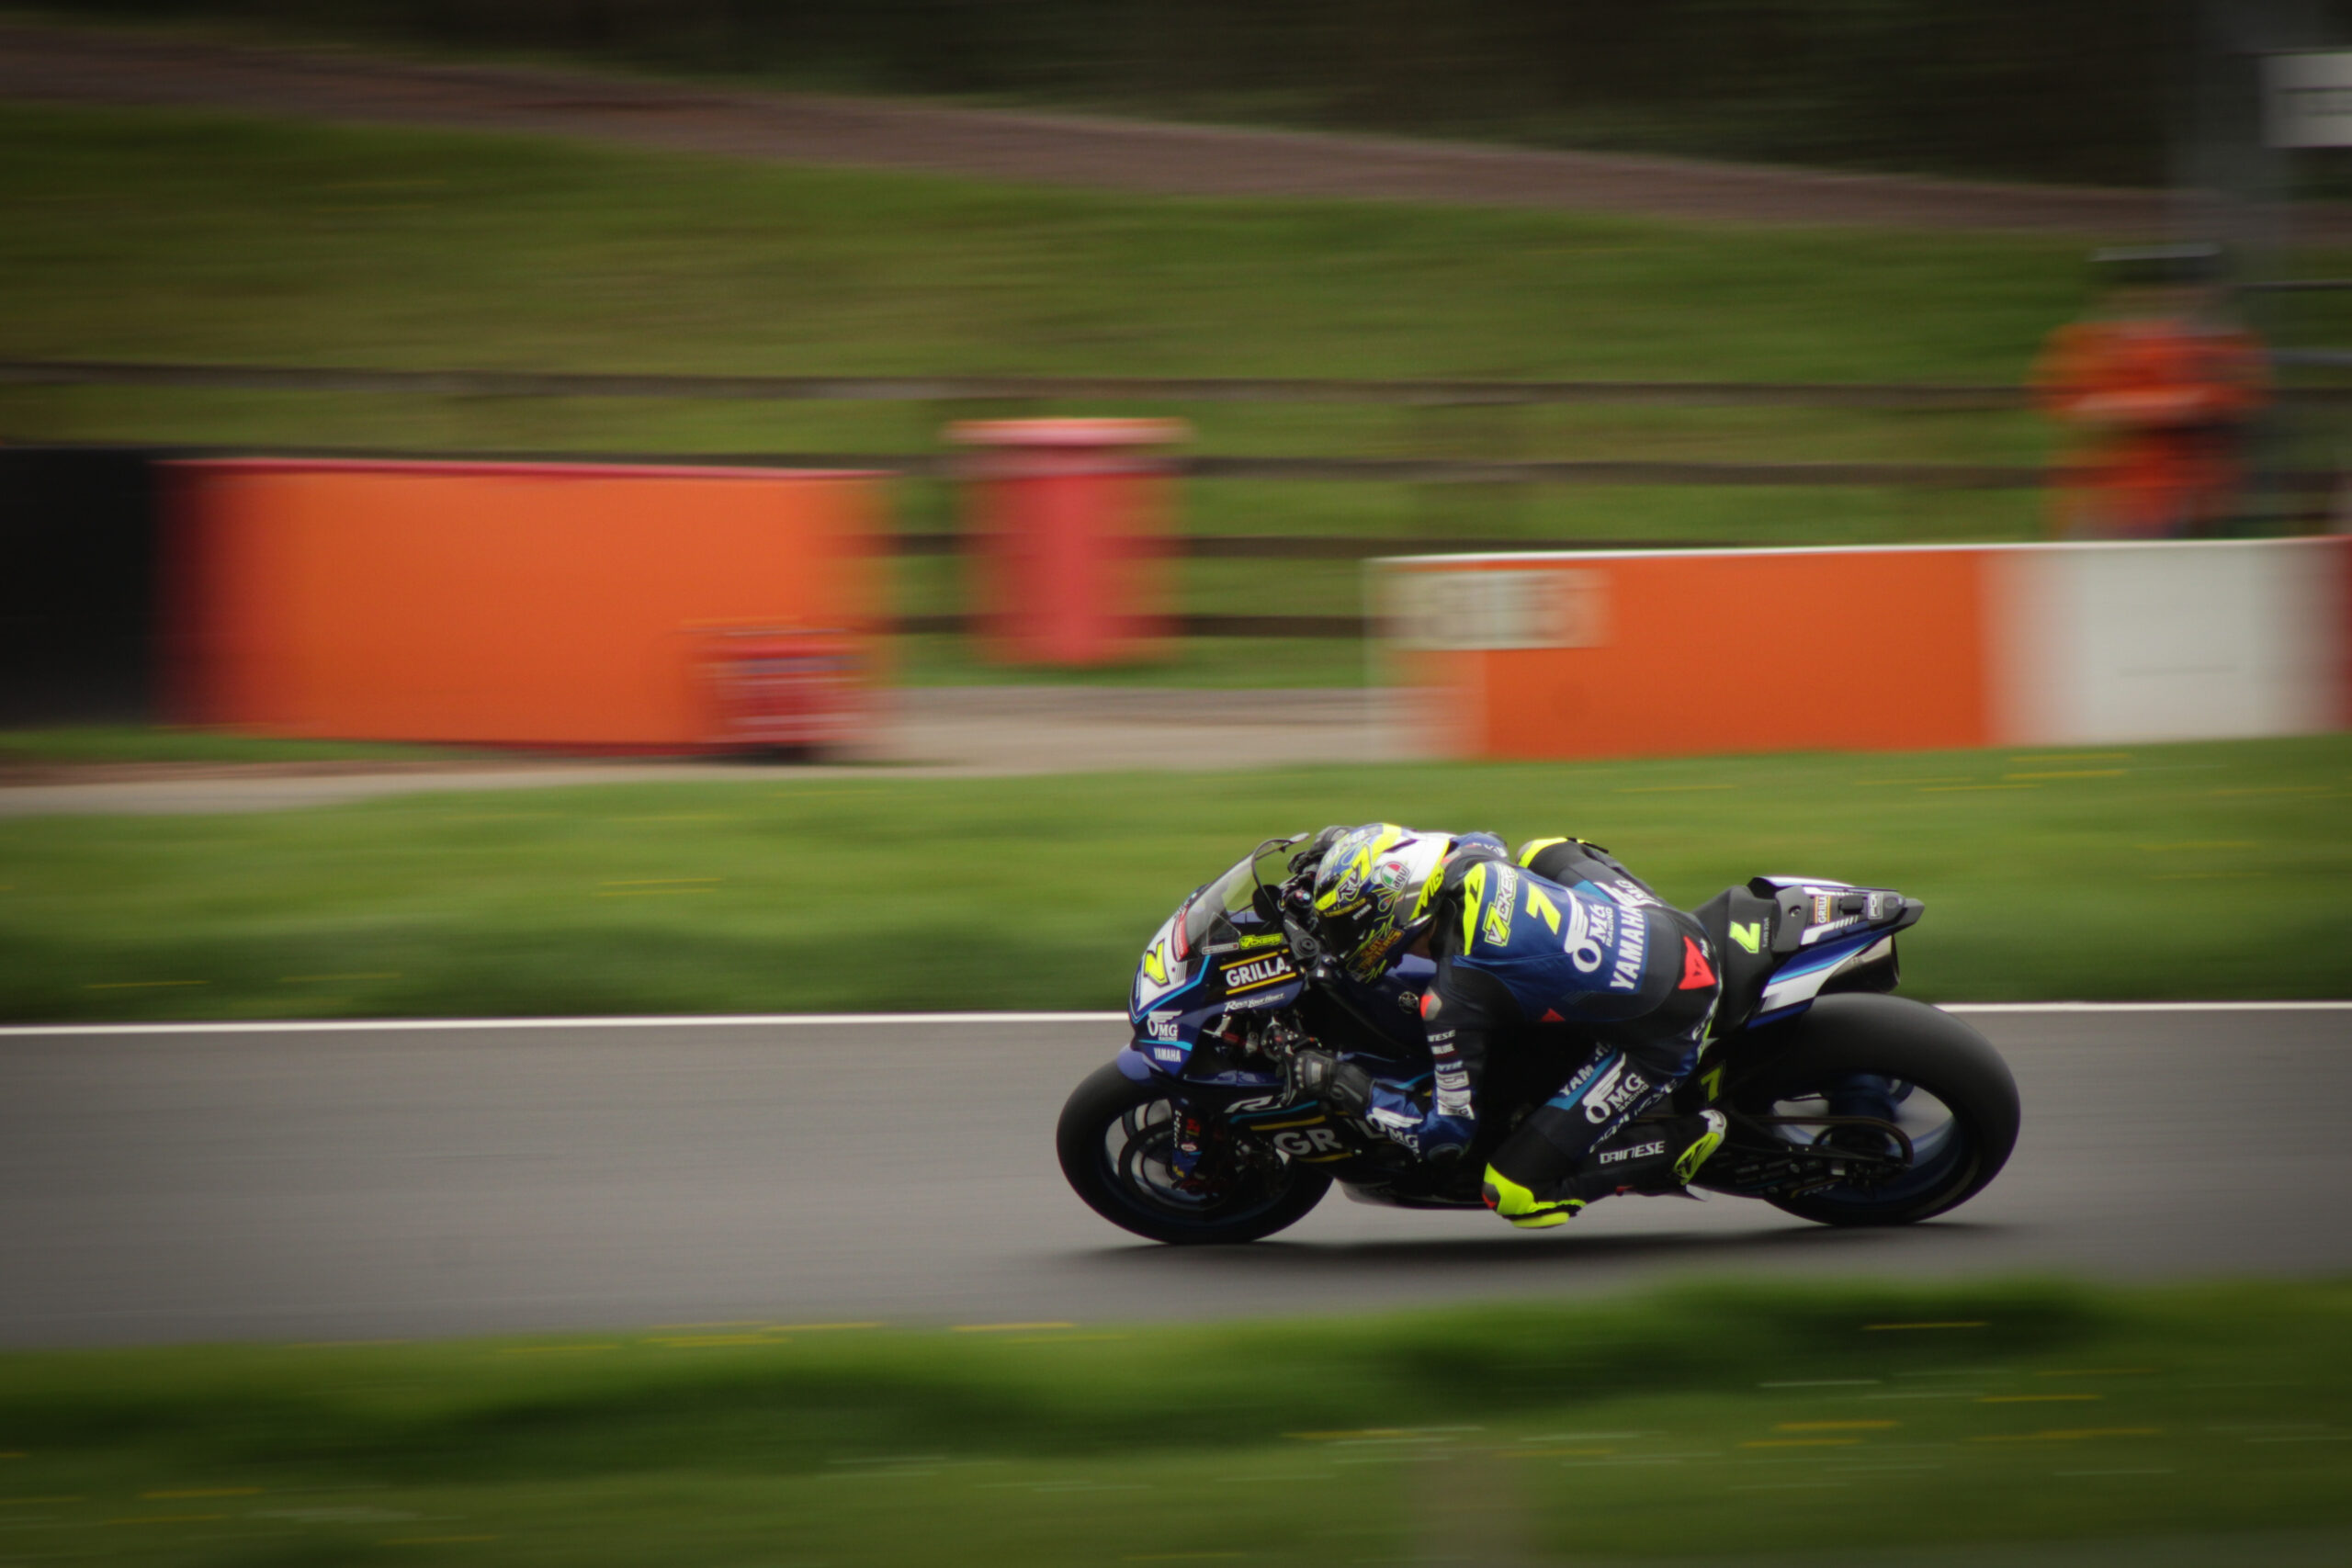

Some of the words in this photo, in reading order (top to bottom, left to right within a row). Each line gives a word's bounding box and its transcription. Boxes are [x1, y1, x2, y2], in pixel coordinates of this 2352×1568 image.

[1525, 882, 1562, 936] 7
[1570, 898, 1605, 973] OMG
[1610, 904, 1645, 990] YAMAHA
[1147, 1014, 1180, 1037] OMG
[1154, 1047, 1182, 1063] YAMAHA
[1584, 1069, 1650, 1124] OMG
[1618, 1084, 1650, 1113] RACING
[1700, 1066, 1724, 1102] 7
[1600, 1141, 1666, 1165] DAINESE
